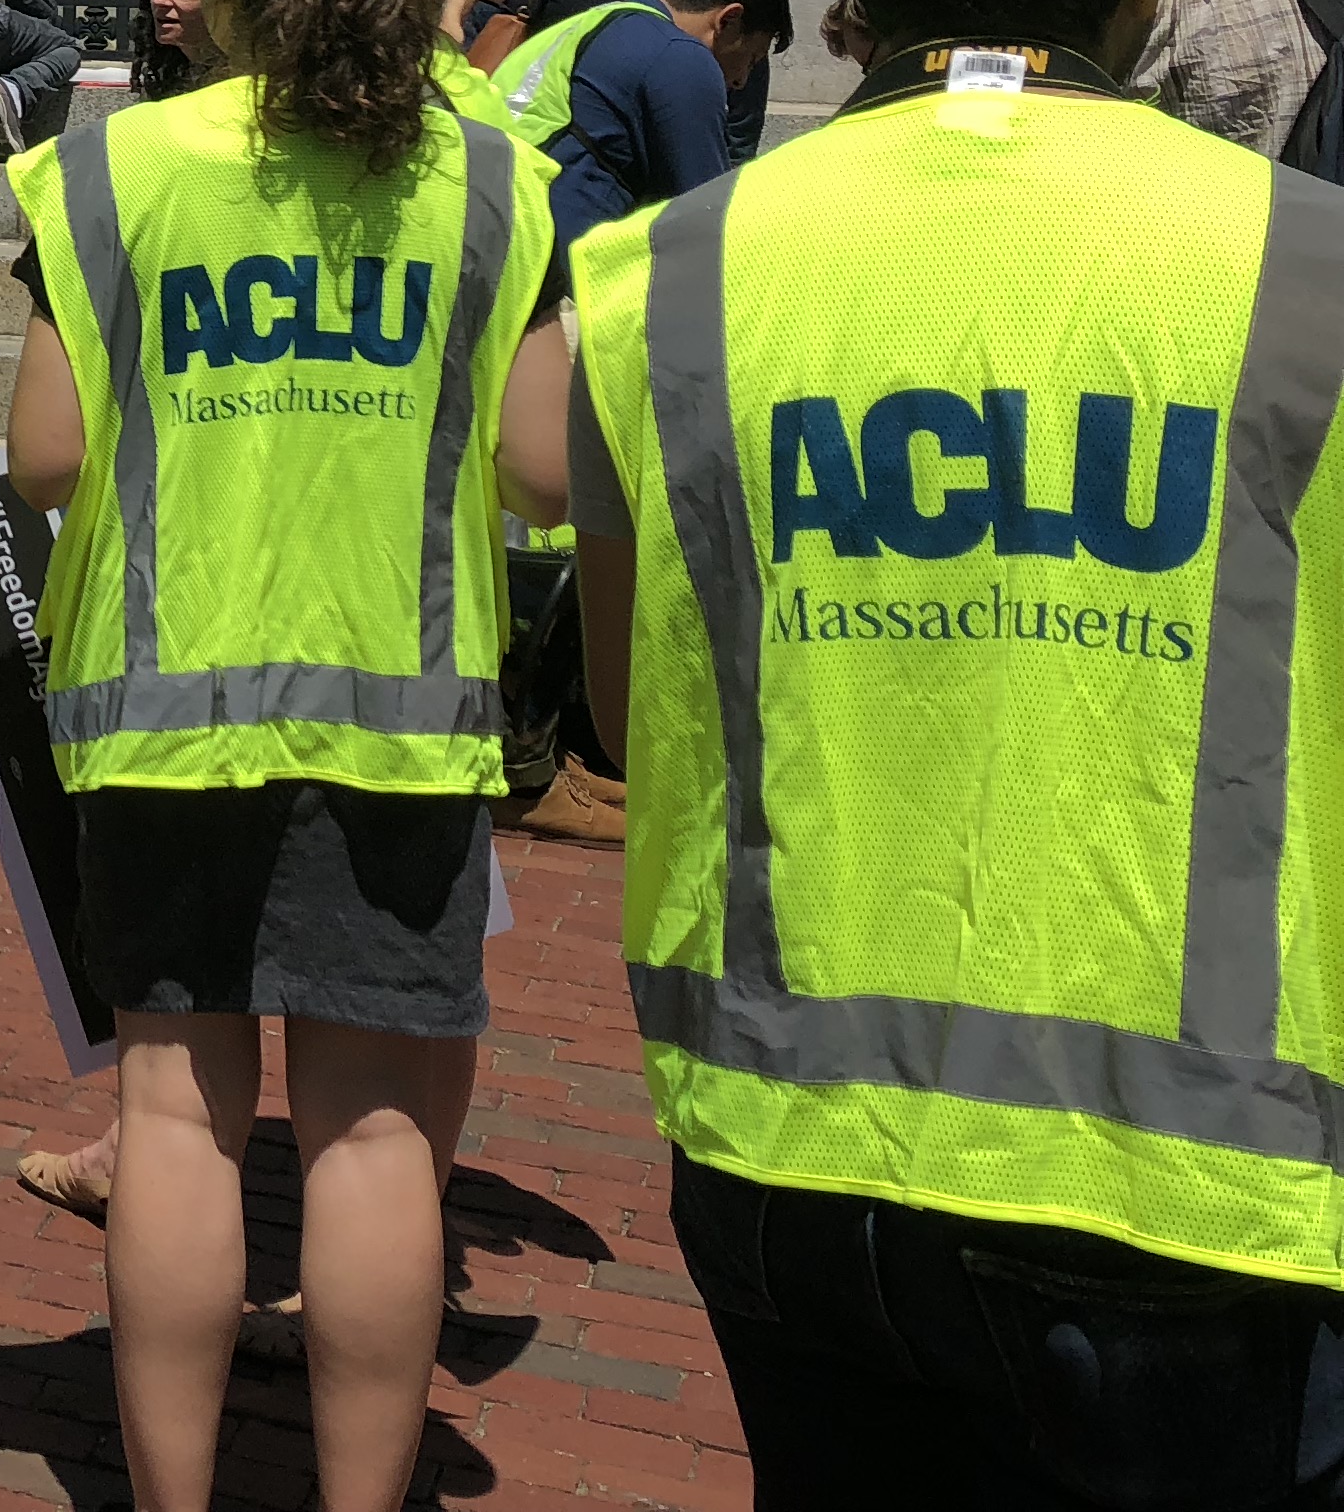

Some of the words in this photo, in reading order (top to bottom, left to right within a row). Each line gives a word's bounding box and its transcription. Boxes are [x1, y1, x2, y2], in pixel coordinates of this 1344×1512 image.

[161, 254, 435, 376] ACLU
[168, 377, 417, 427] Massachusetts
[770, 388, 1219, 575] ACLU
[770, 583, 1196, 663] Massachusetts
